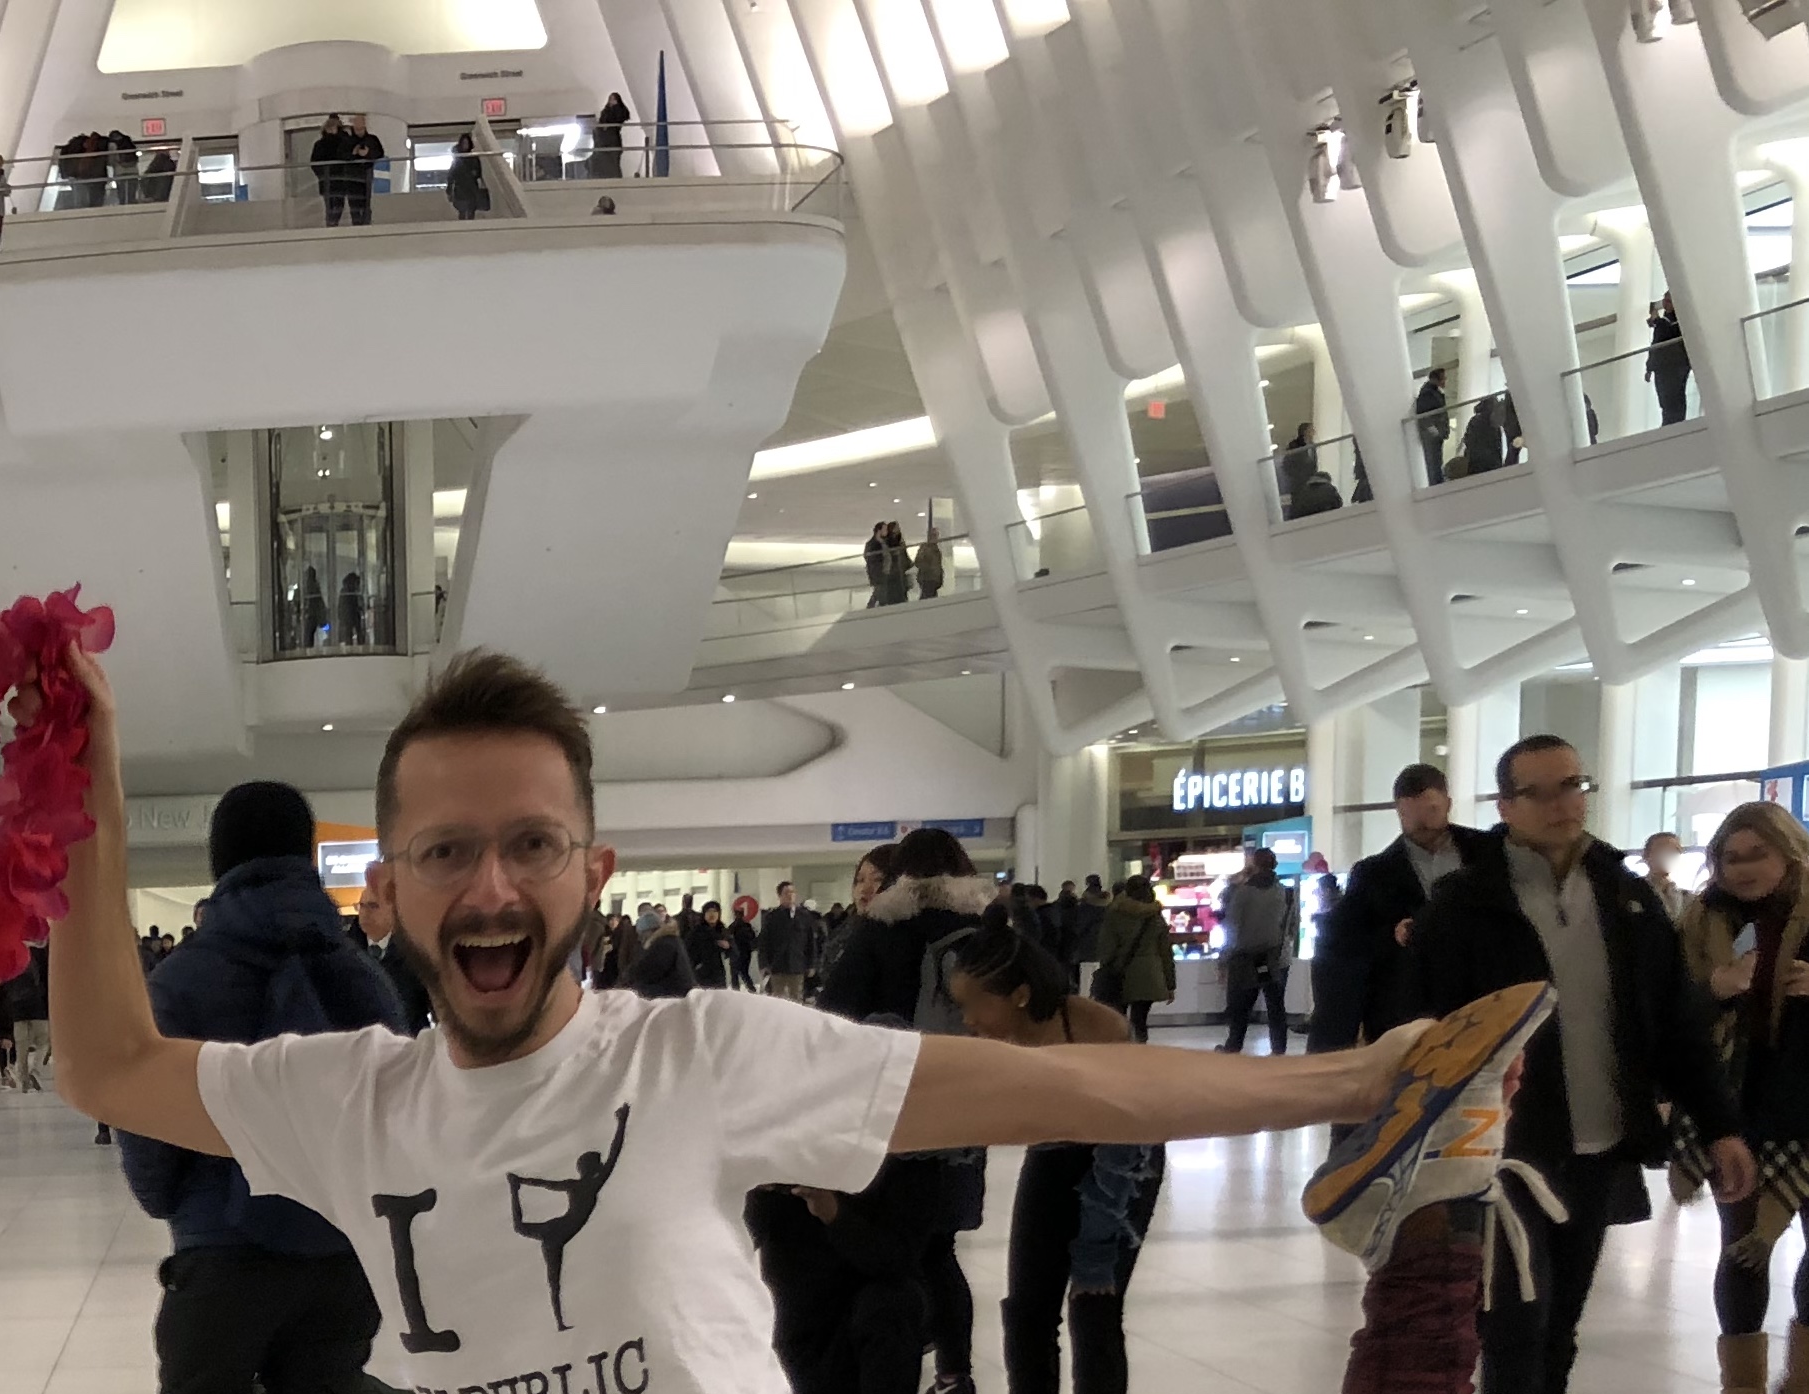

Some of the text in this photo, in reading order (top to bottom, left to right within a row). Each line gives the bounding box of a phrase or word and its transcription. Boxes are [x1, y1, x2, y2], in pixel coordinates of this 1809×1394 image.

[1173, 767, 1285, 811] ÉPICERIE
[139, 804, 191, 831] New
[371, 1188, 460, 1354] I
